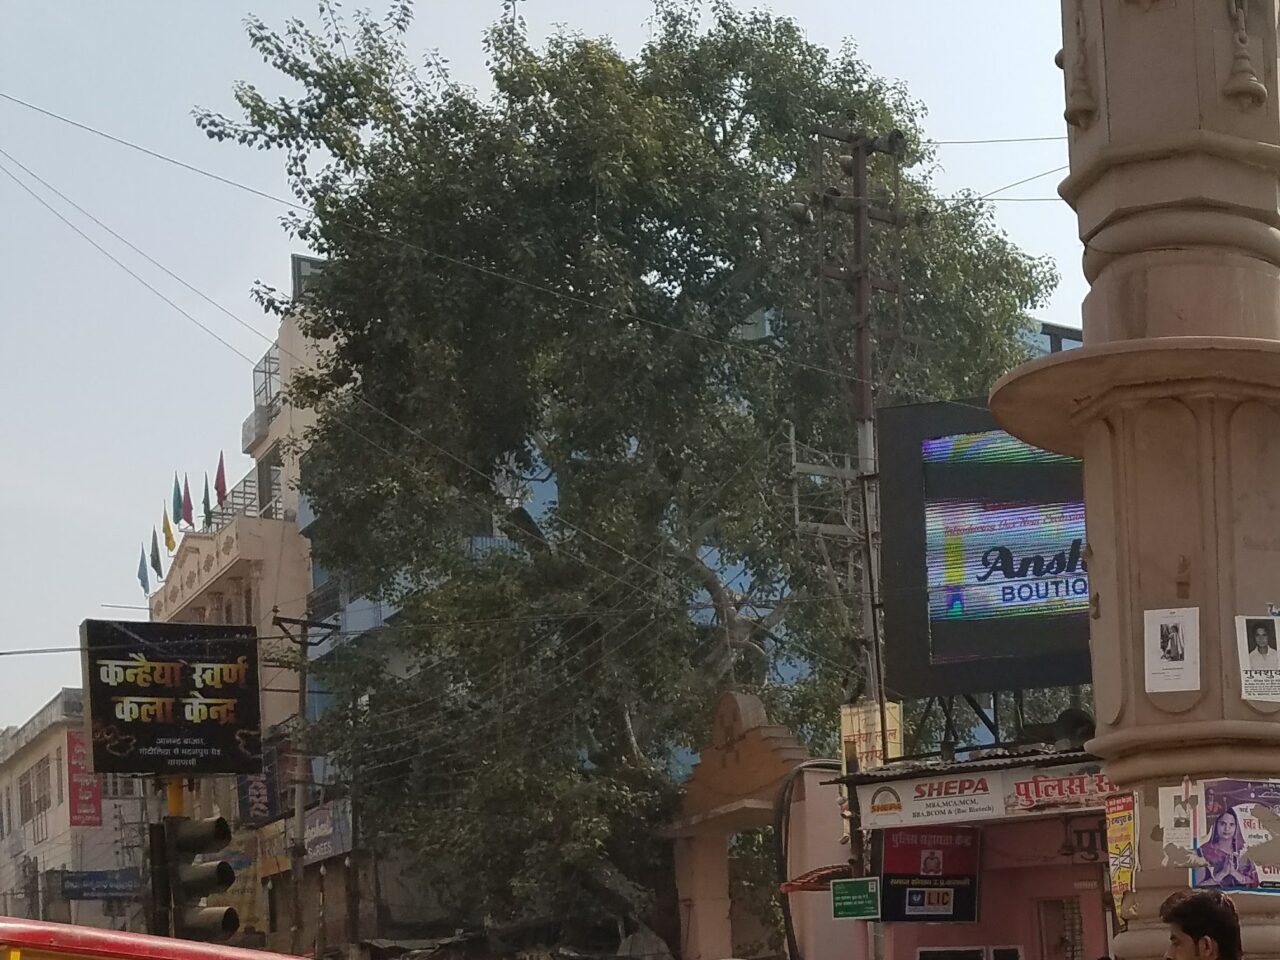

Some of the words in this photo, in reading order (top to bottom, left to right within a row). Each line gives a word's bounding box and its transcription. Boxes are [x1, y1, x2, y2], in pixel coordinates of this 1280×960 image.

[97, 653, 185, 689] कन्हैया
[189, 655, 250, 690] स्वर्ण
[112, 696, 176, 724] कला
[179, 690, 238, 724] केन्द्र
[913, 778, 989, 798] SHEPA
[1014, 774, 1089, 809] पुलिस
[927, 893, 950, 906] LIC
